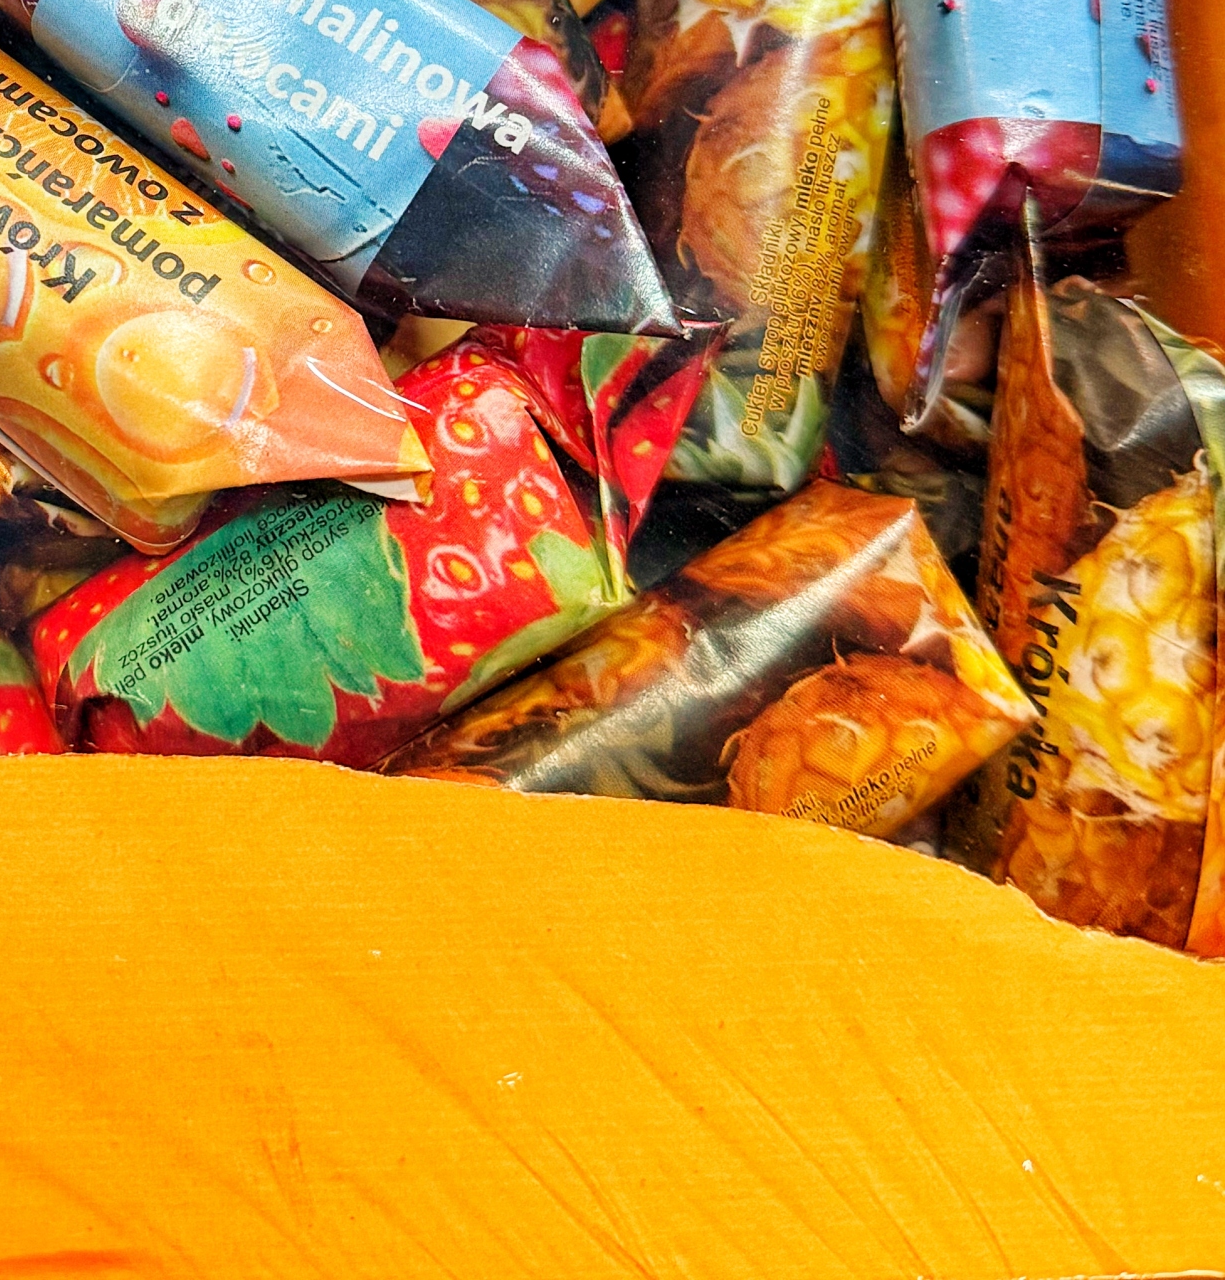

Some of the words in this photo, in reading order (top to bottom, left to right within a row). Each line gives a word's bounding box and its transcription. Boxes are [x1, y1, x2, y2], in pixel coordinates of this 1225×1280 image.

[168, 200, 205, 227] z
[740, 372, 773, 439] Cukier,
[758, 309, 781, 370] syrop
[772, 216, 808, 317] glukozowy,
[794, 151, 819, 211] mleko
[809, 96, 832, 150] pełne
[750, 217, 786, 306] Składniki:
[770, 393, 787, 412] w
[804, 199, 826, 255] masło
[815, 132, 842, 198] tłuszcz
[795, 294, 823, 378] mleczny
[814, 309, 836, 372] owoce
[255, 496, 329, 552] mleczny
[301, 520, 350, 561] syrop
[149, 528, 255, 607] liofilizowane.
[204, 554, 300, 629] glukozowy,
[179, 583, 233, 627] masło
[224, 577, 310, 642] Składniki:
[117, 623, 179, 670] tłuszcz
[147, 624, 205, 671] mleko
[837, 771, 891, 813] mleko
